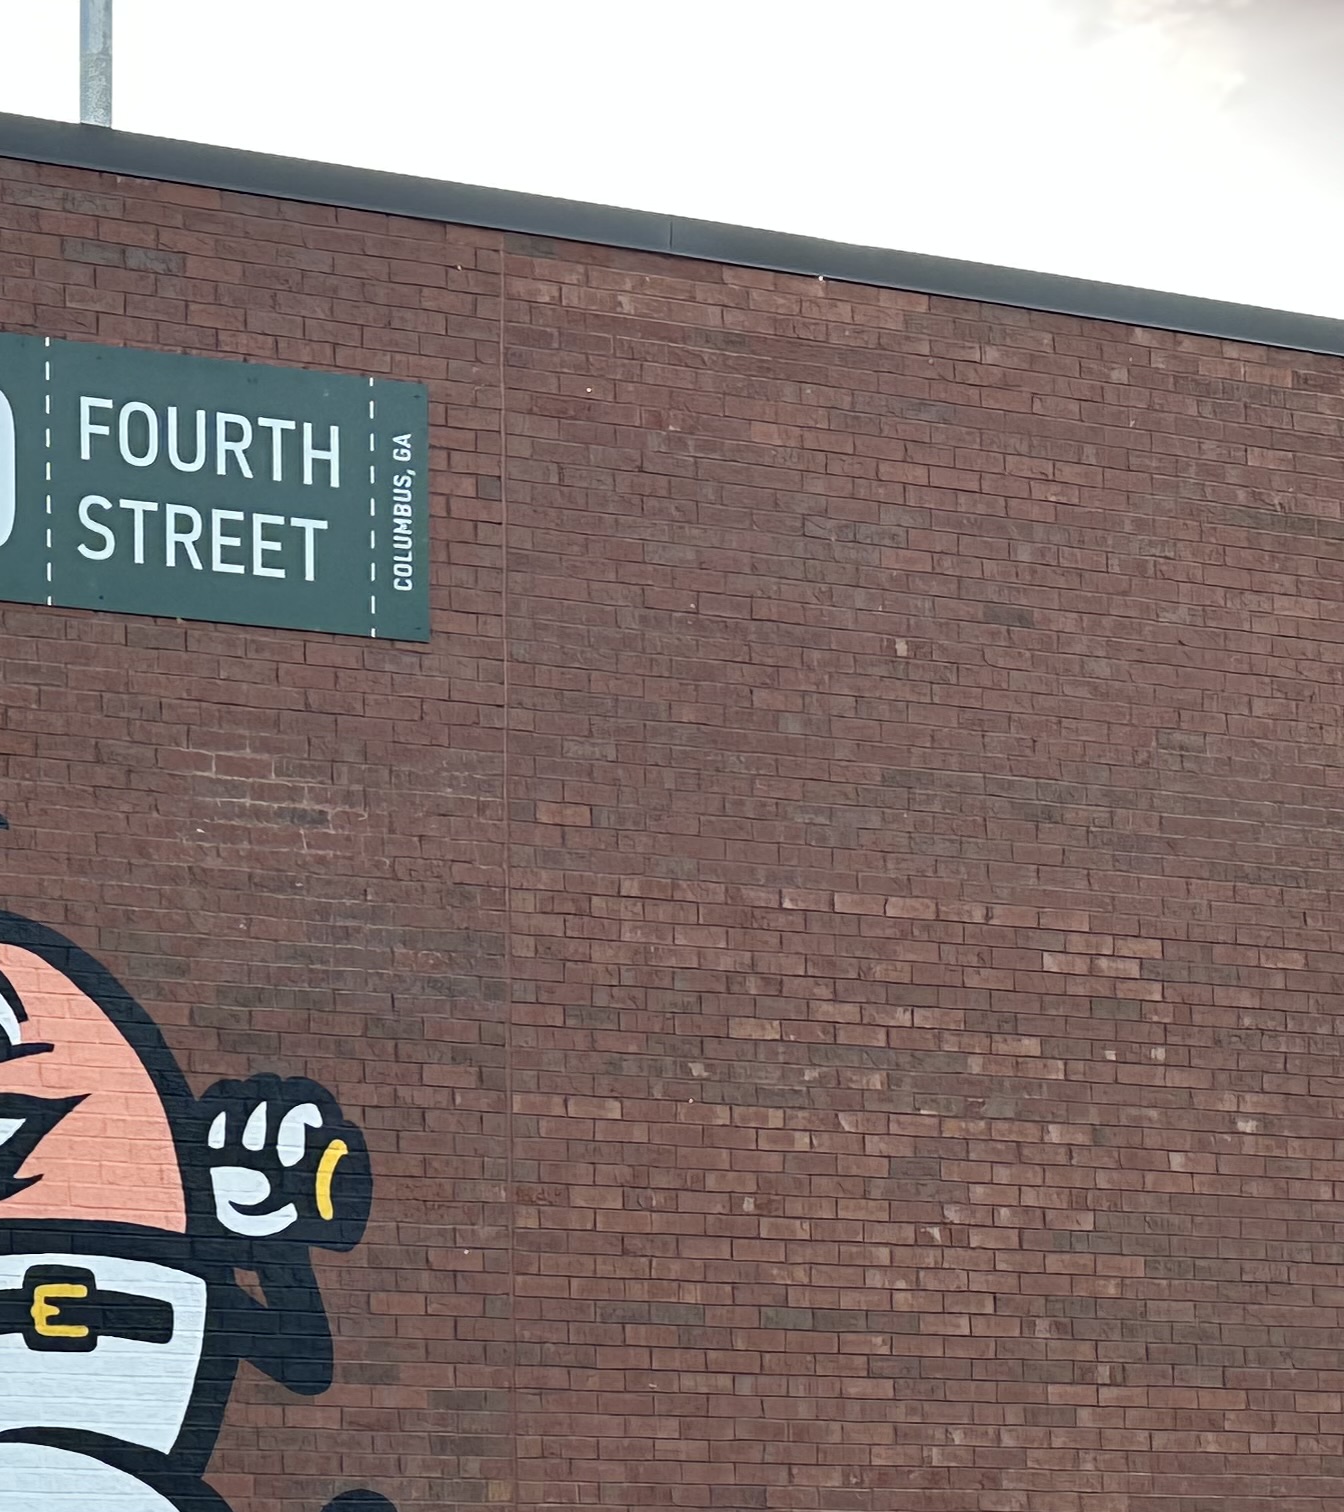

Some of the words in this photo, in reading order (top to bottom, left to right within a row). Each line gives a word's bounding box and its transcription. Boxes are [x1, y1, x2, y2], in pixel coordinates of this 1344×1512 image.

[79, 395, 341, 488] FOURTH
[392, 433, 412, 462] GA
[77, 495, 329, 582] STREET
[392, 469, 416, 591] COLUMBUS,
